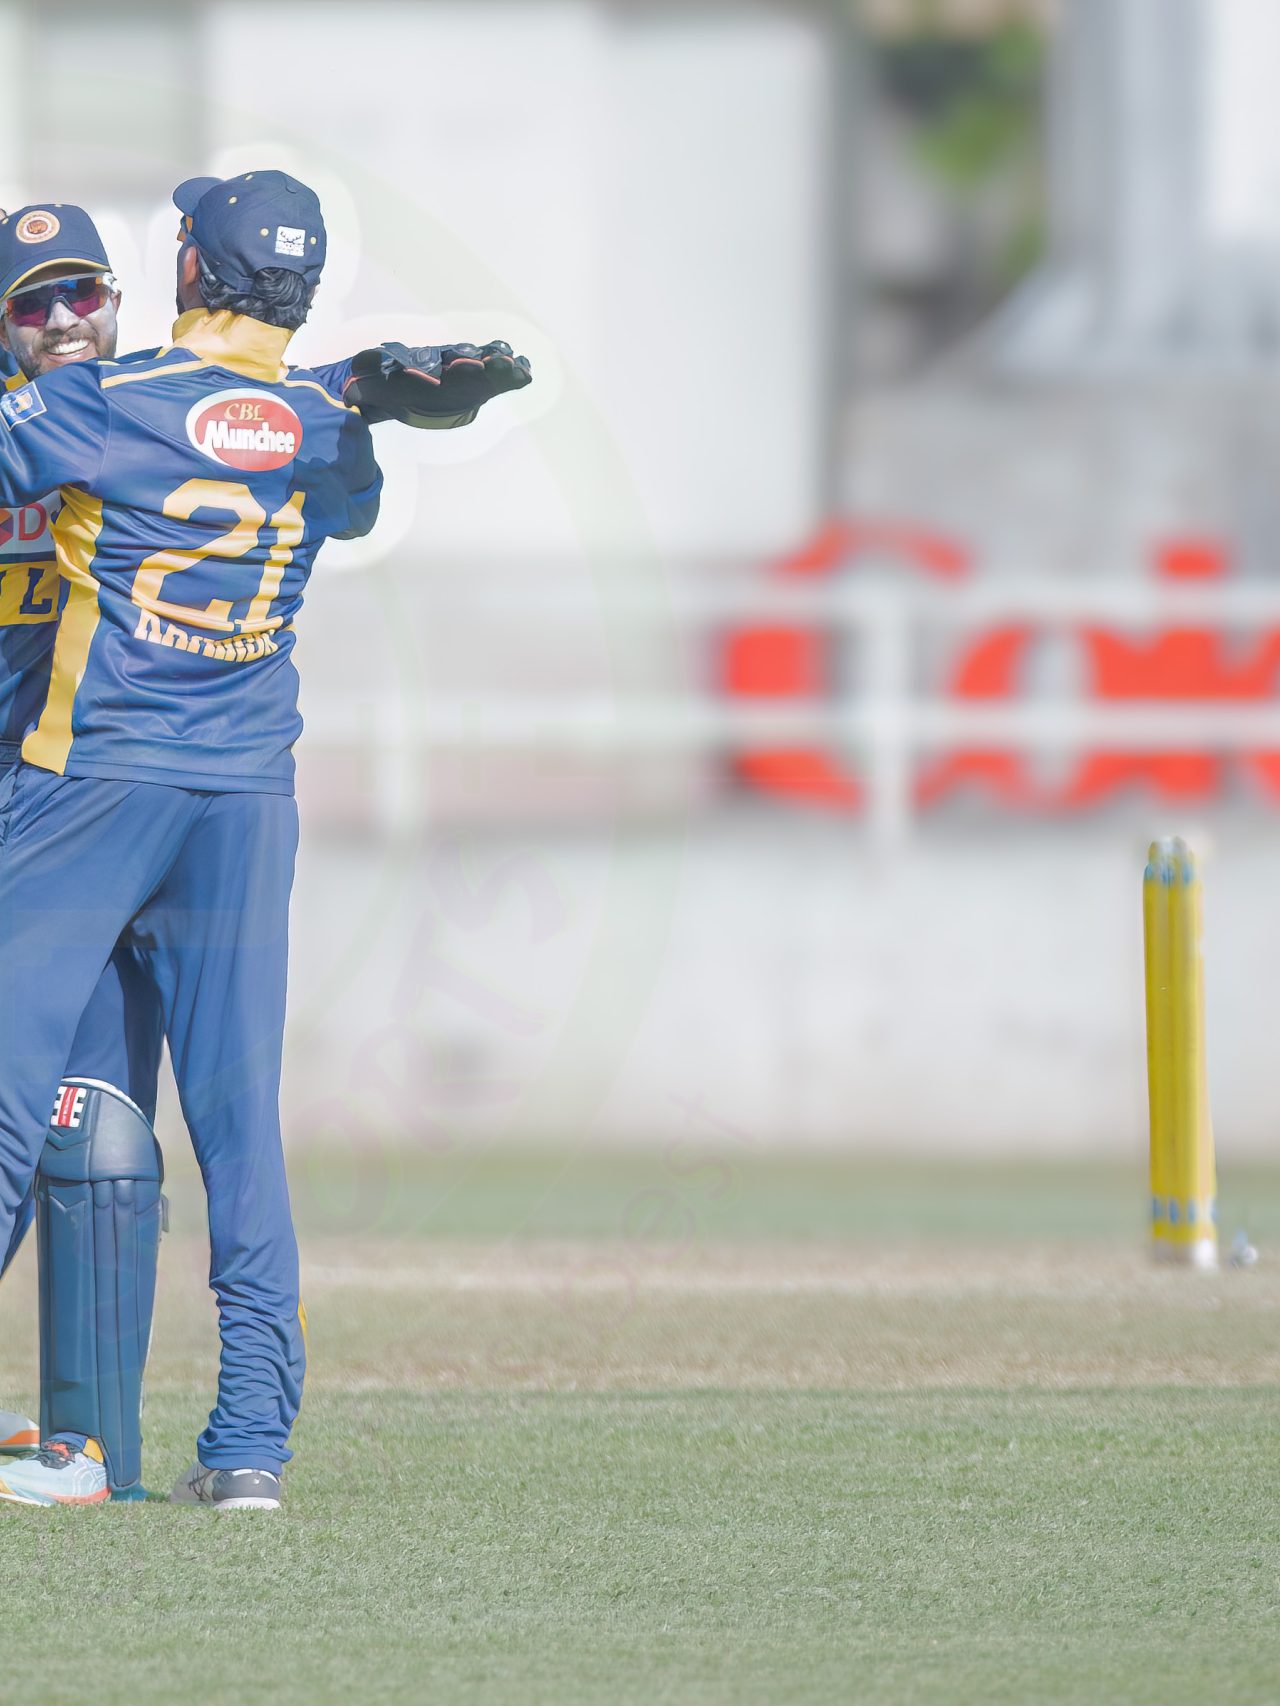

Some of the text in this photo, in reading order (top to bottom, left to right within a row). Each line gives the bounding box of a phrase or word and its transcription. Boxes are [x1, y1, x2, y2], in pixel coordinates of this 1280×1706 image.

[224, 403, 265, 421] CBL
[203, 420, 295, 454] Munchee
[132, 478, 307, 633] 21
